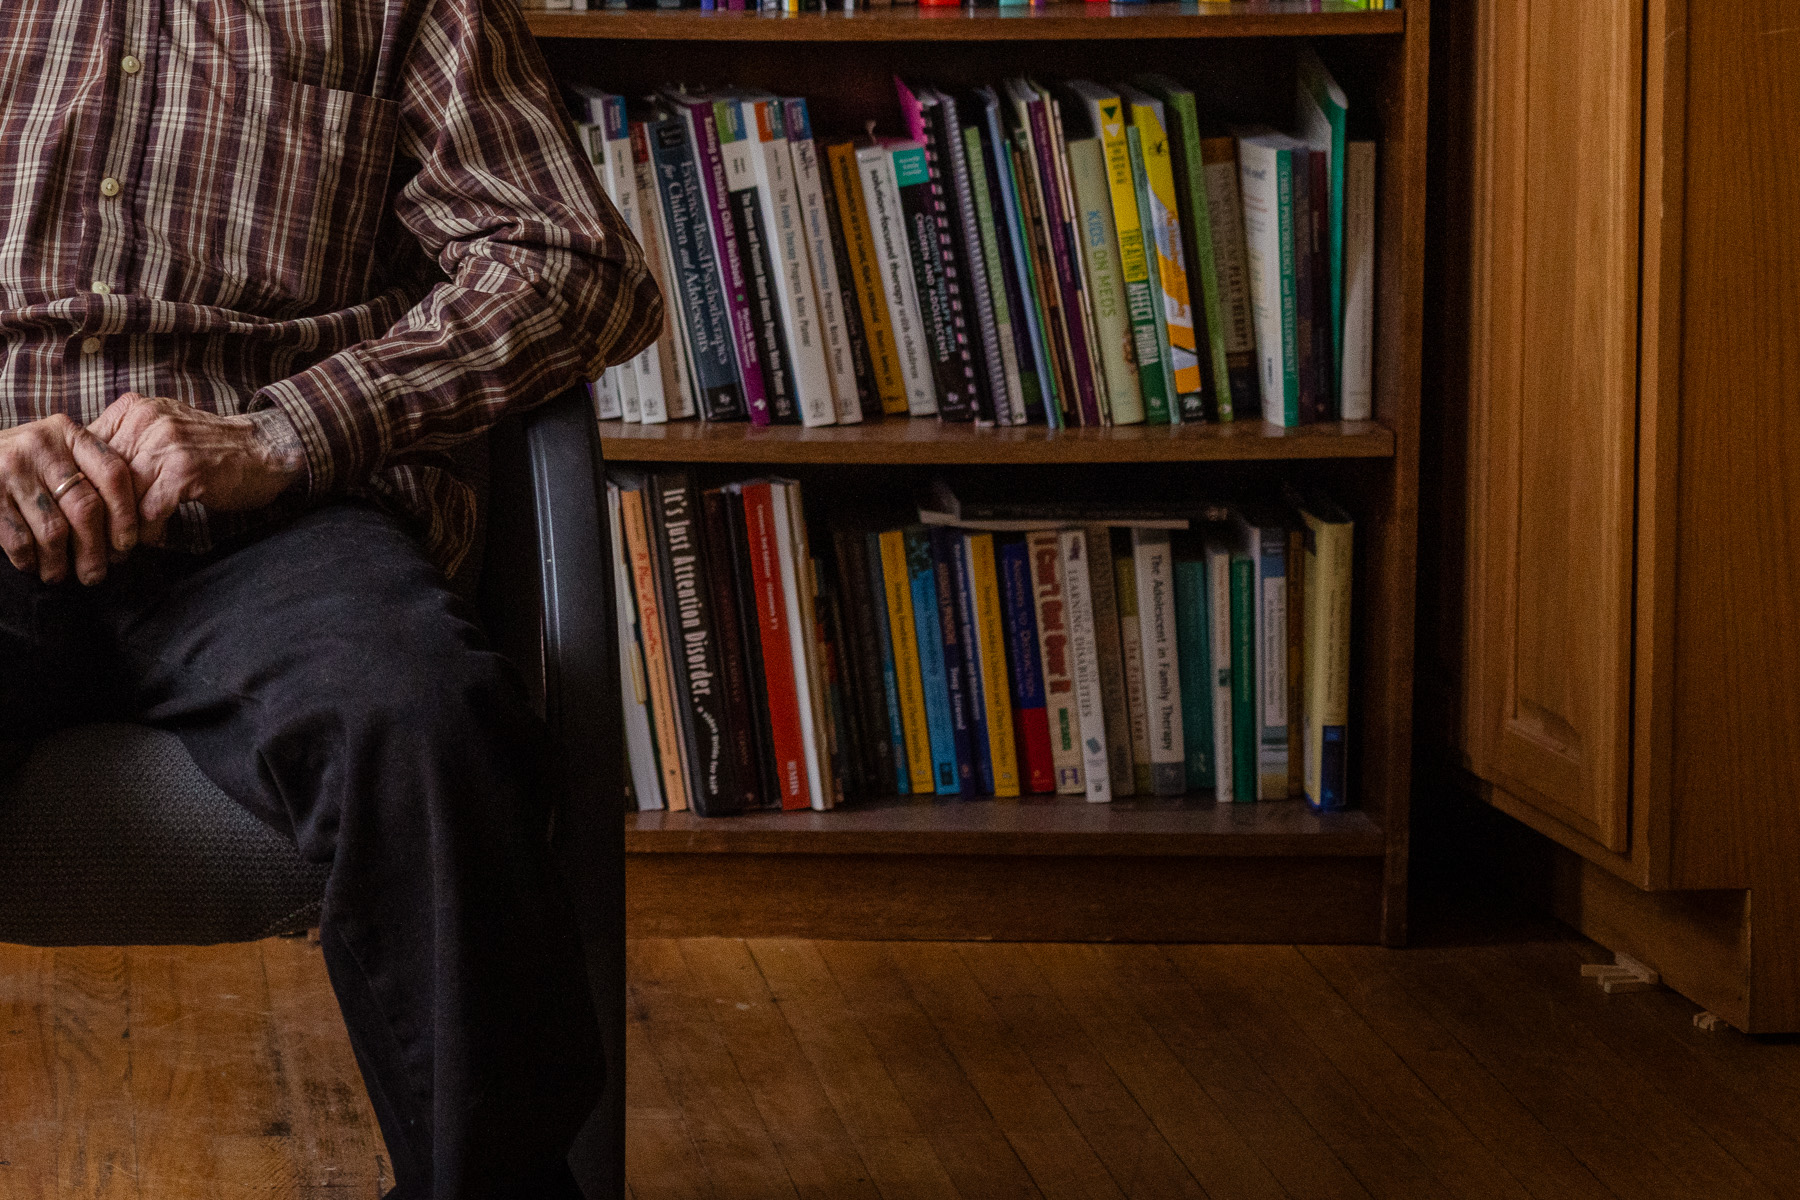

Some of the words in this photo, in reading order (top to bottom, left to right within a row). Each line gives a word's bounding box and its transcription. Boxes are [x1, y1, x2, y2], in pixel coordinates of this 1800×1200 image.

[1279, 171, 1292, 203] CHILD
[668, 182, 689, 245] Children
[869, 169, 901, 258] solution-focused
[1087, 210, 1105, 248] KIDS
[679, 248, 696, 268] and
[913, 213, 932, 260] CHILDREN
[1119, 228, 1148, 281] TREATING
[1280, 205, 1294, 276] PSYCHOLOGY
[924, 263, 937, 286] AND
[1092, 250, 1108, 272] ON
[884, 262, 905, 306] therapy
[1097, 274, 1116, 317] MEDS
[1126, 282, 1153, 321] AFFECT
[684, 271, 708, 353] Adolescents
[795, 296, 807, 317] Notes
[928, 289, 950, 363] ADOLESCENTS
[934, 277, 950, 322] THERAPY
[943, 326, 957, 353] WITH
[799, 319, 812, 347] Planner
[1133, 324, 1159, 367] PHOBIA
[1283, 296, 1296, 374] DEVELOPMENT
[902, 333, 920, 380] children
[663, 488, 688, 517] It's
[664, 521, 691, 552] Just
[1035, 549, 1061, 598] Can't
[1151, 554, 1166, 574] The
[673, 556, 703, 629] Attention
[1067, 569, 1086, 629] LEARNING
[1153, 577, 1169, 642] Adolescent
[1039, 601, 1065, 630] Get
[1042, 634, 1068, 677] Over
[1155, 646, 1168, 659] in
[1074, 633, 1092, 718] DISABILITIES
[1155, 662, 1173, 701] Family
[1155, 704, 1175, 752] Therapy
